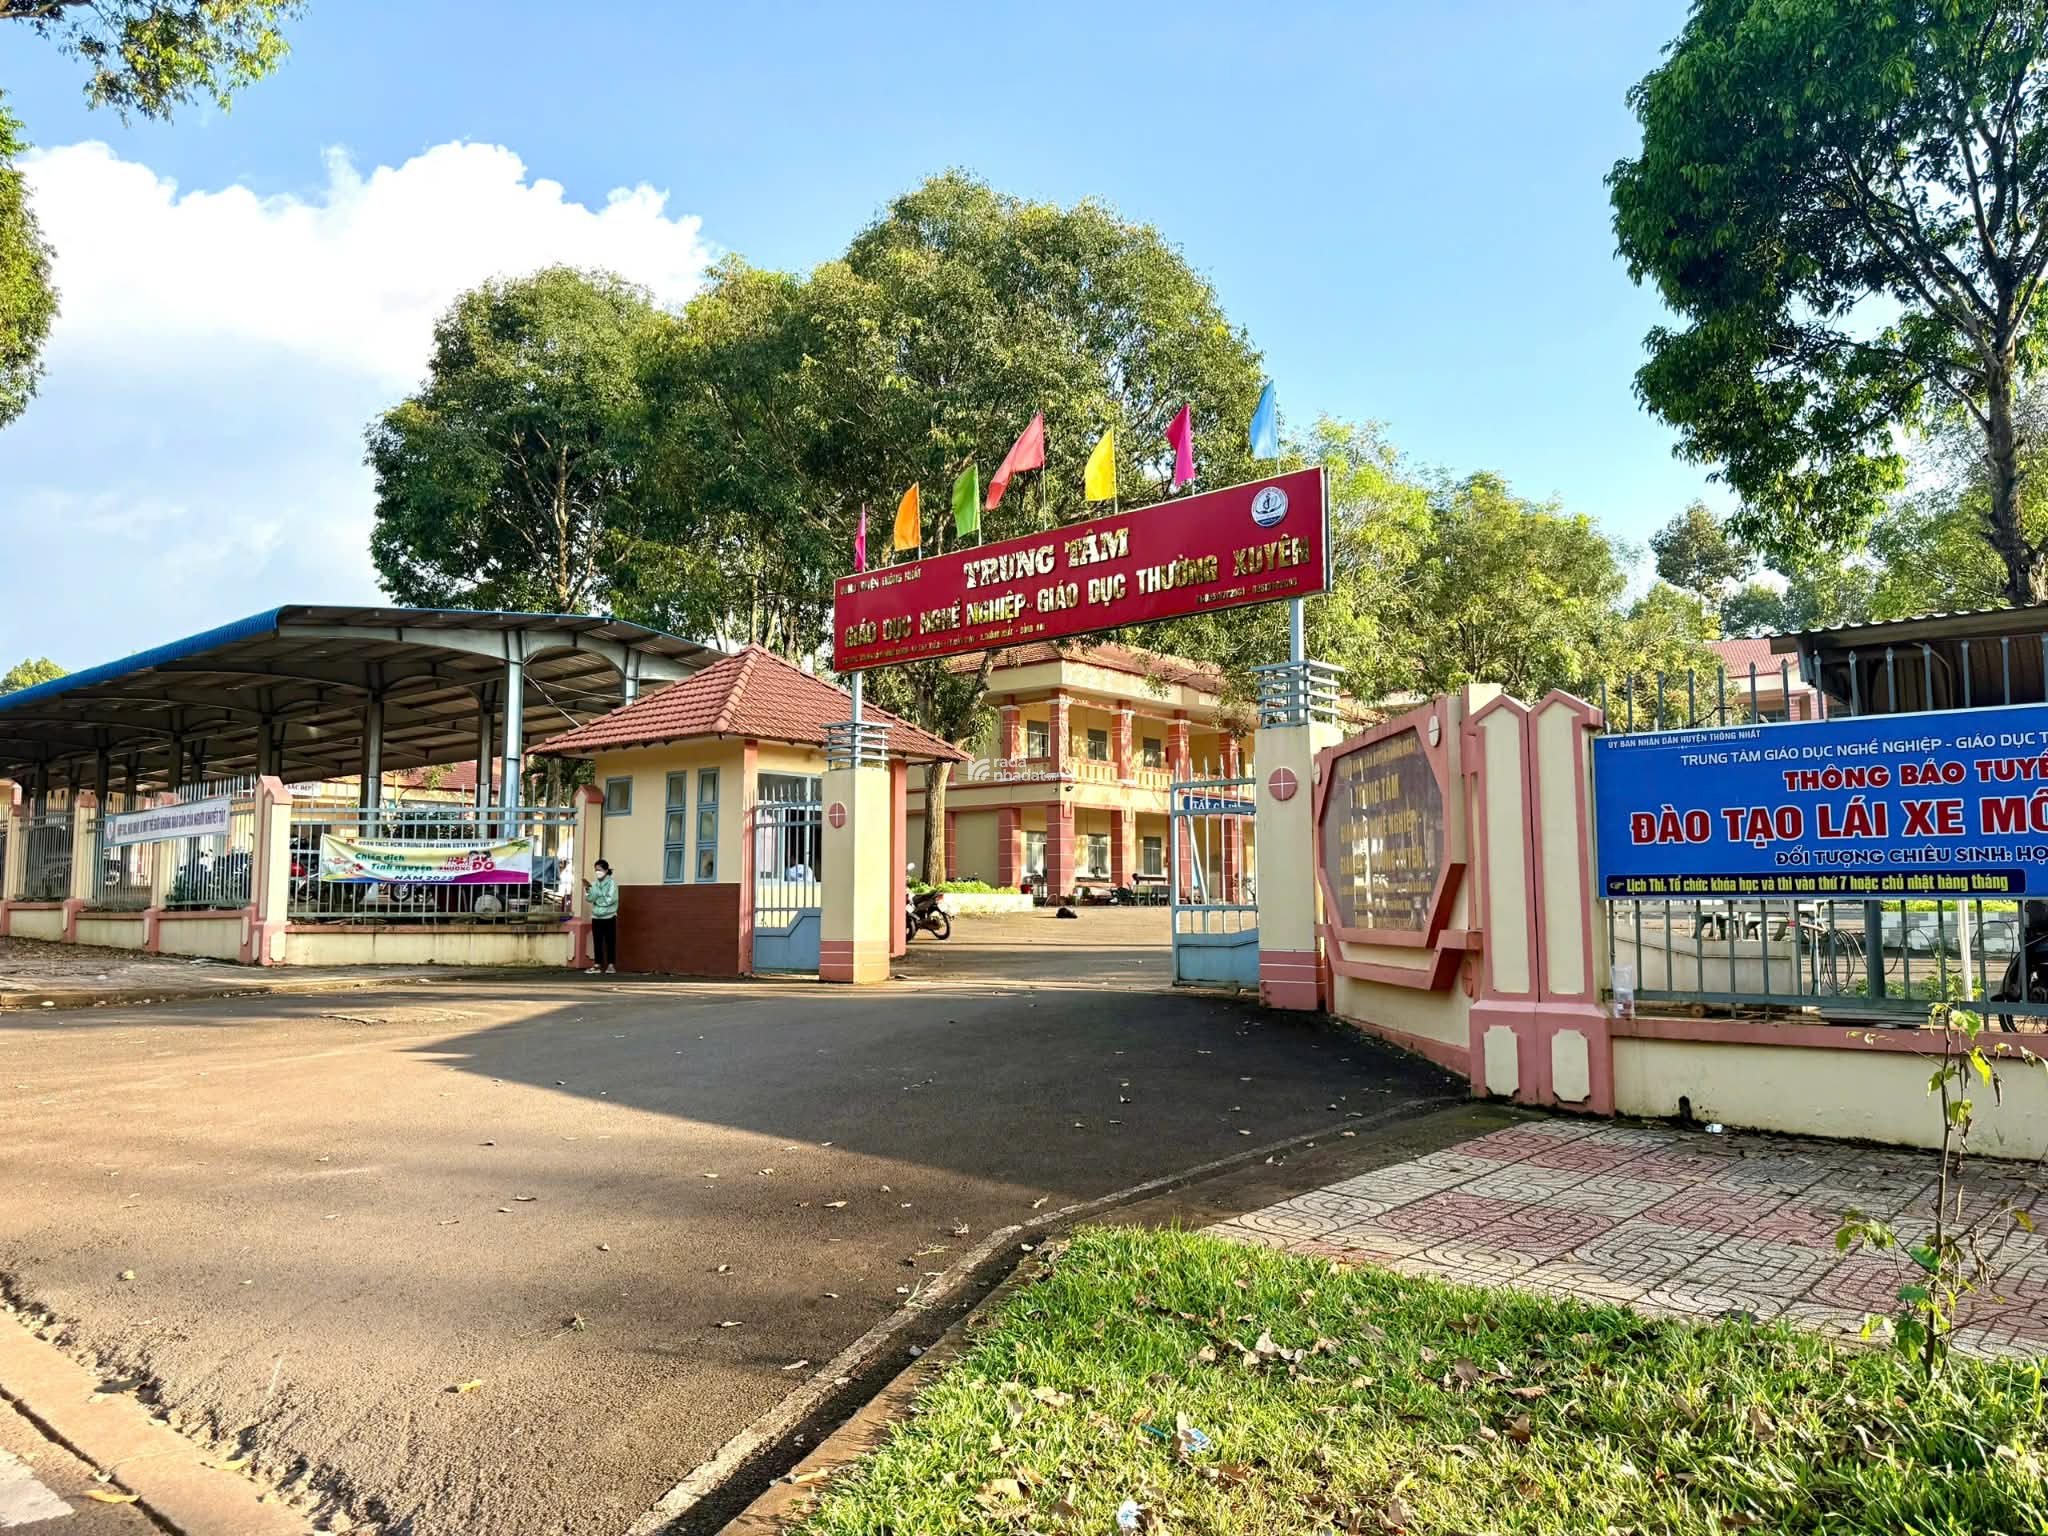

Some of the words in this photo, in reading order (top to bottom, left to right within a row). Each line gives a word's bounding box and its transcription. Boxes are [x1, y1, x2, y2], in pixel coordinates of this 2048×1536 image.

[964, 545, 1055, 589] TRUNG
[1064, 527, 1129, 568] TÂM
[844, 617, 877, 648] GIÁO
[883, 614, 912, 644] DỤC
[920, 597, 961, 635] NGHỀ
[967, 590, 1026, 625] NGHIỆP
[1037, 580, 1079, 613] GIÁO
[1088, 573, 1126, 606] DỤC
[1136, 554, 1218, 595] THƯỜNG
[1233, 533, 1310, 577] XUYÊN
[1620, 739, 1636, 748] BAN
[1638, 736, 1660, 746] NHÂN
[1662, 734, 1679, 745] DÂN
[1680, 733, 1707, 744] HUYỆN
[1709, 730, 1737, 741] THỐNG
[1739, 728, 1761, 739] NHẤT
[1680, 754, 1728, 766] TRUNG
[1731, 749, 1761, 764] TÂM
[1764, 744, 1799, 761] GIÁO
[1803, 745, 1833, 760] DỤC
[1837, 739, 1879, 757] NGHỀ
[1882, 737, 1942, 754] NGHIỆP
[1955, 732, 1996, 749] GIÁO
[2000, 732, 2036, 748] DỤC
[1783, 763, 1891, 792] THÔNG
[1898, 758, 1967, 786] BÁO
[1630, 804, 1712, 845] ĐÀO
[1721, 805, 1804, 848] TẠO
[1816, 795, 1889, 839] LÁI
[1901, 798, 1966, 837] XE
[1980, 787, 2048, 835] MÔ
[1775, 845, 1810, 866] ĐỐI
[1814, 848, 1886, 869] TƯỢNG
[1888, 843, 1950, 864] CHIÊU
[1955, 846, 2013, 863] SINH:
[2016, 846, 2048, 865] HỌ
[1626, 878, 1647, 895] Lịch
[1668, 875, 1682, 892] Tổ
[1683, 877, 1708, 892] chức
[1711, 877, 1737, 892] khóa
[1739, 877, 1758, 895] học
[1761, 877, 1775, 891] và
[1778, 876, 1793, 891] thi
[1795, 875, 1815, 891] vào
[1818, 875, 1838, 891] thứ
[1840, 876, 1847, 890] 7
[1850, 875, 1879, 894] hoặc
[1882, 873, 1904, 890] chủ
[1907, 873, 1936, 893] nhật
[1937, 874, 1968, 892] hàng
[1971, 873, 2009, 892] tháng
